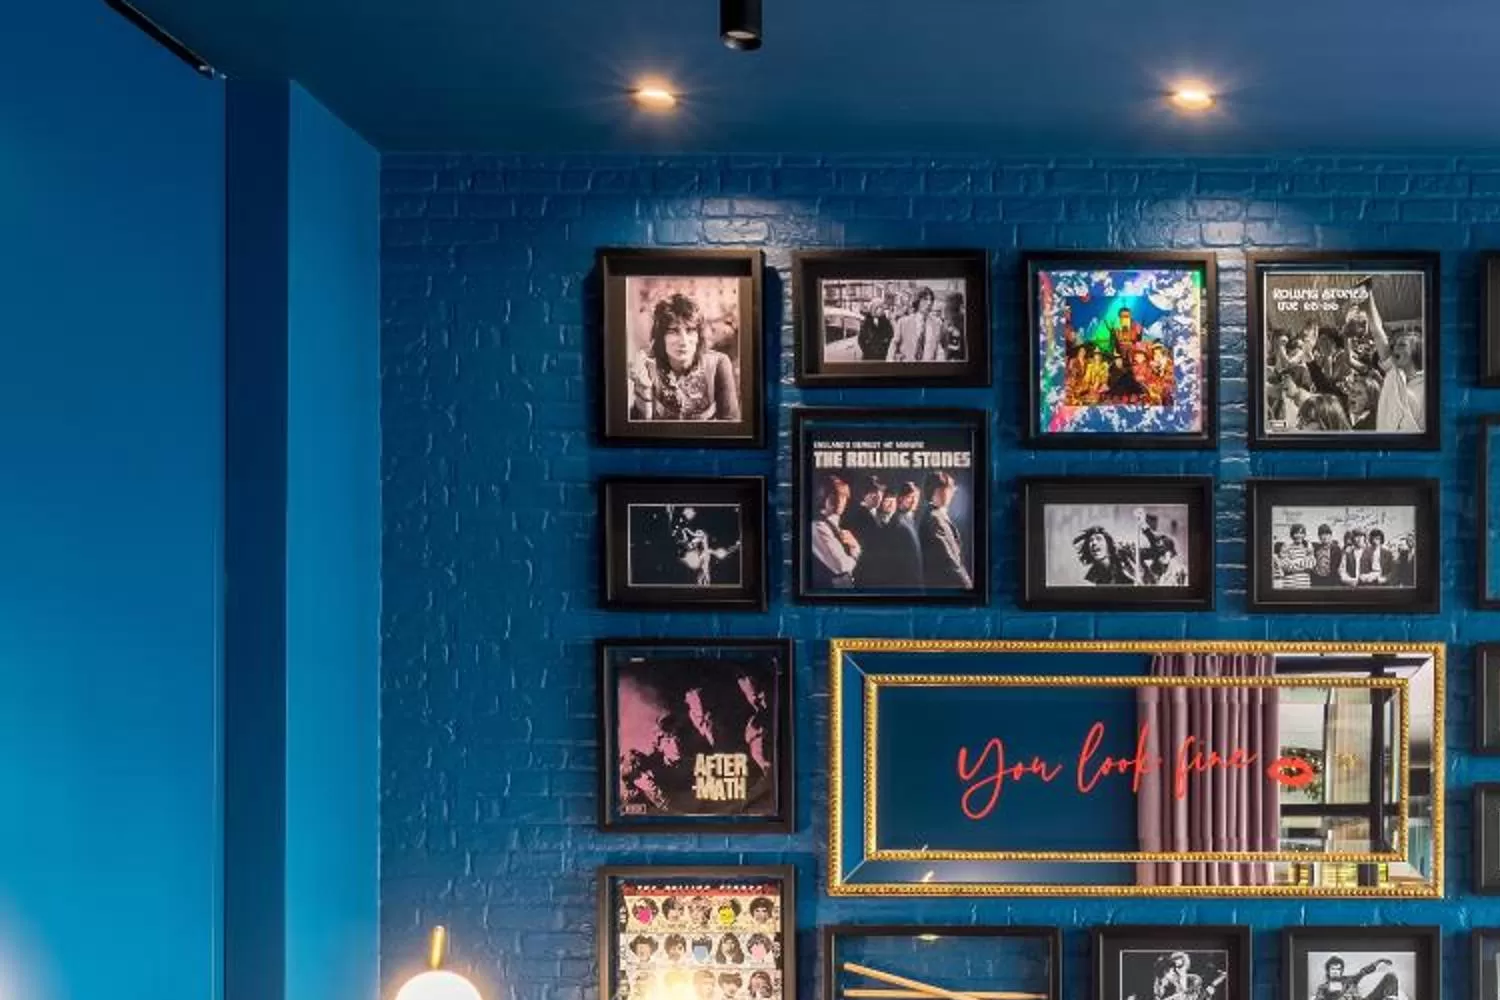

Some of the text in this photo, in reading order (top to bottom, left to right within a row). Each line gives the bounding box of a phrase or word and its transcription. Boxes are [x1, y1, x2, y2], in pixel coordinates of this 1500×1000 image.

[813, 451, 971, 468] THE ROLLING STONES
[694, 753, 749, 777] AFTER
[956, 721, 1258, 820] You look fine
